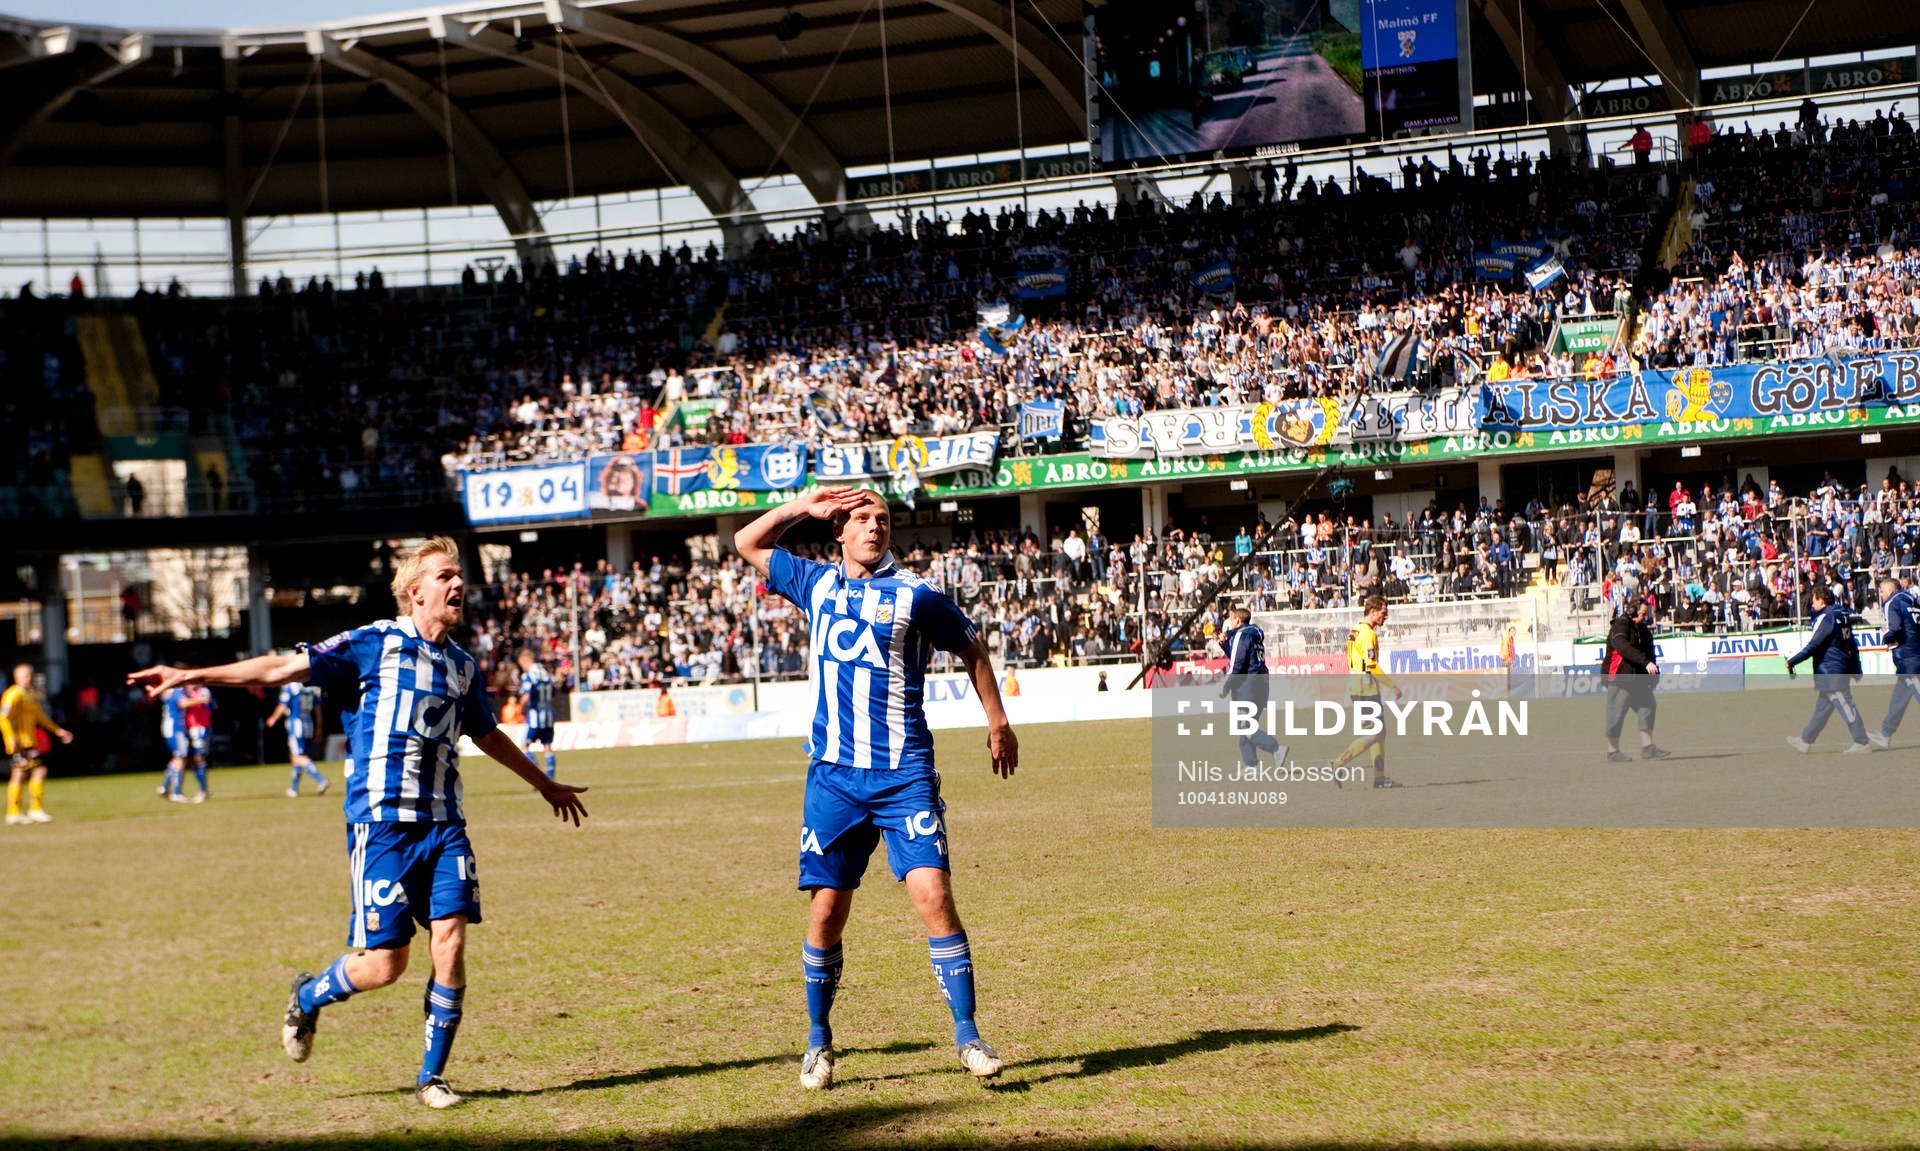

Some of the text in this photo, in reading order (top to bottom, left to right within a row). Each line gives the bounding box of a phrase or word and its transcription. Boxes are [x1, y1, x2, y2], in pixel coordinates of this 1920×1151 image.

[1378, 13, 1438, 30] Malmö FF
[1256, 142, 1300, 156] SAMSUNG
[1482, 374, 1658, 428] ÄLSKA
[481, 482, 512, 508] 19
[539, 476, 577, 503] 04
[848, 589, 863, 598] ICA
[817, 613, 889, 669] ICA
[1707, 634, 1778, 654] JÄRNIA
[364, 879, 409, 907] ICA
